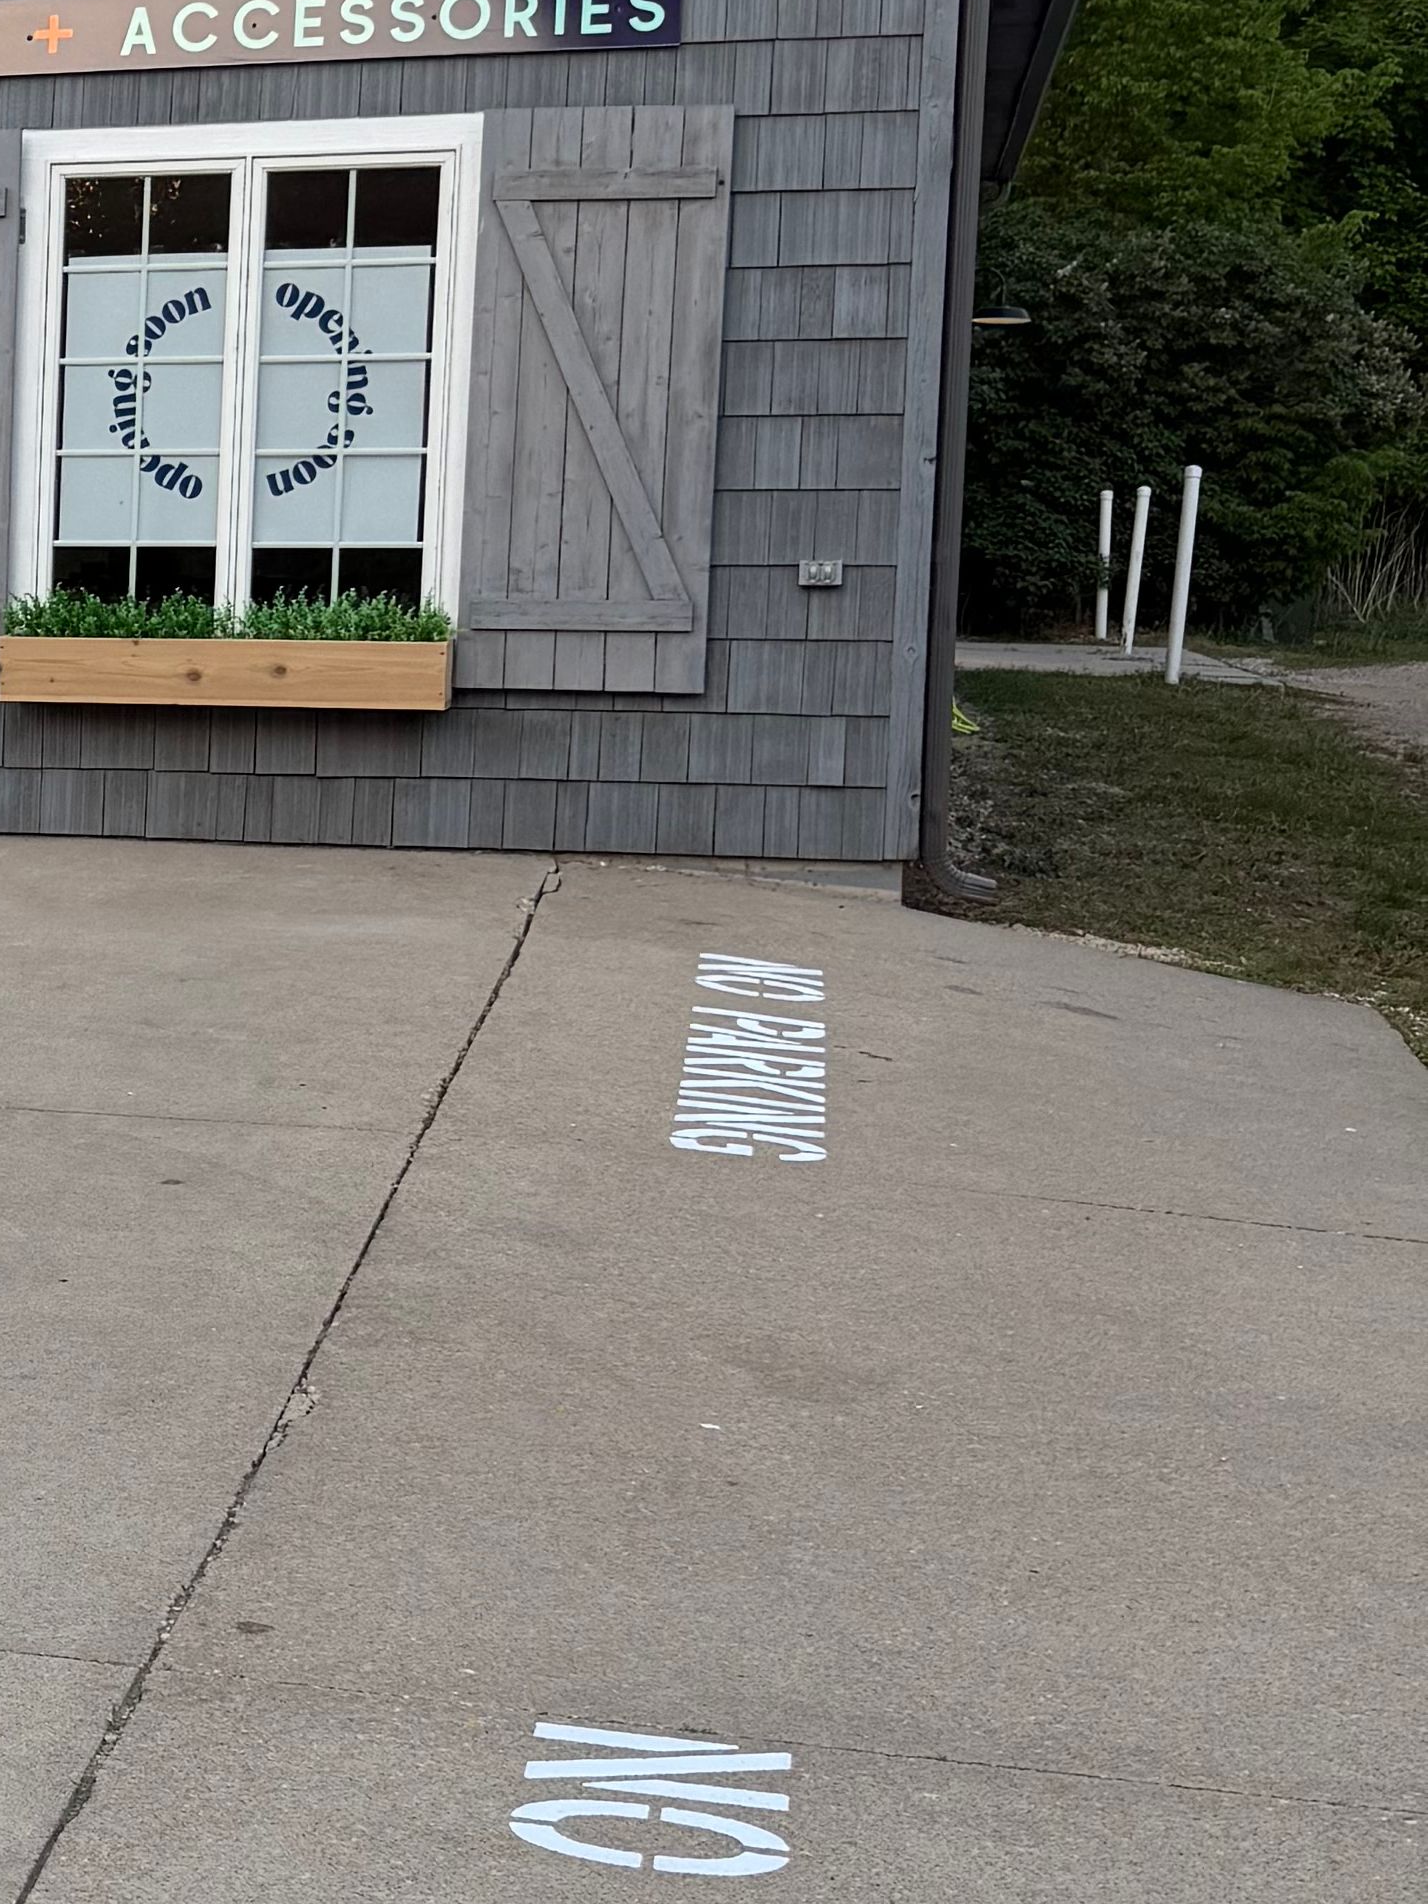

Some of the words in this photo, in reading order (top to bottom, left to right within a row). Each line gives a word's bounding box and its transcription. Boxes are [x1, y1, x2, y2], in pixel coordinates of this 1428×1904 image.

[125, 286, 212, 358] soon
[266, 423, 355, 497] soon
[695, 952, 826, 1002] NO
[669, 1005, 828, 1162] PARKING
[508, 1721, 792, 1877] NO
